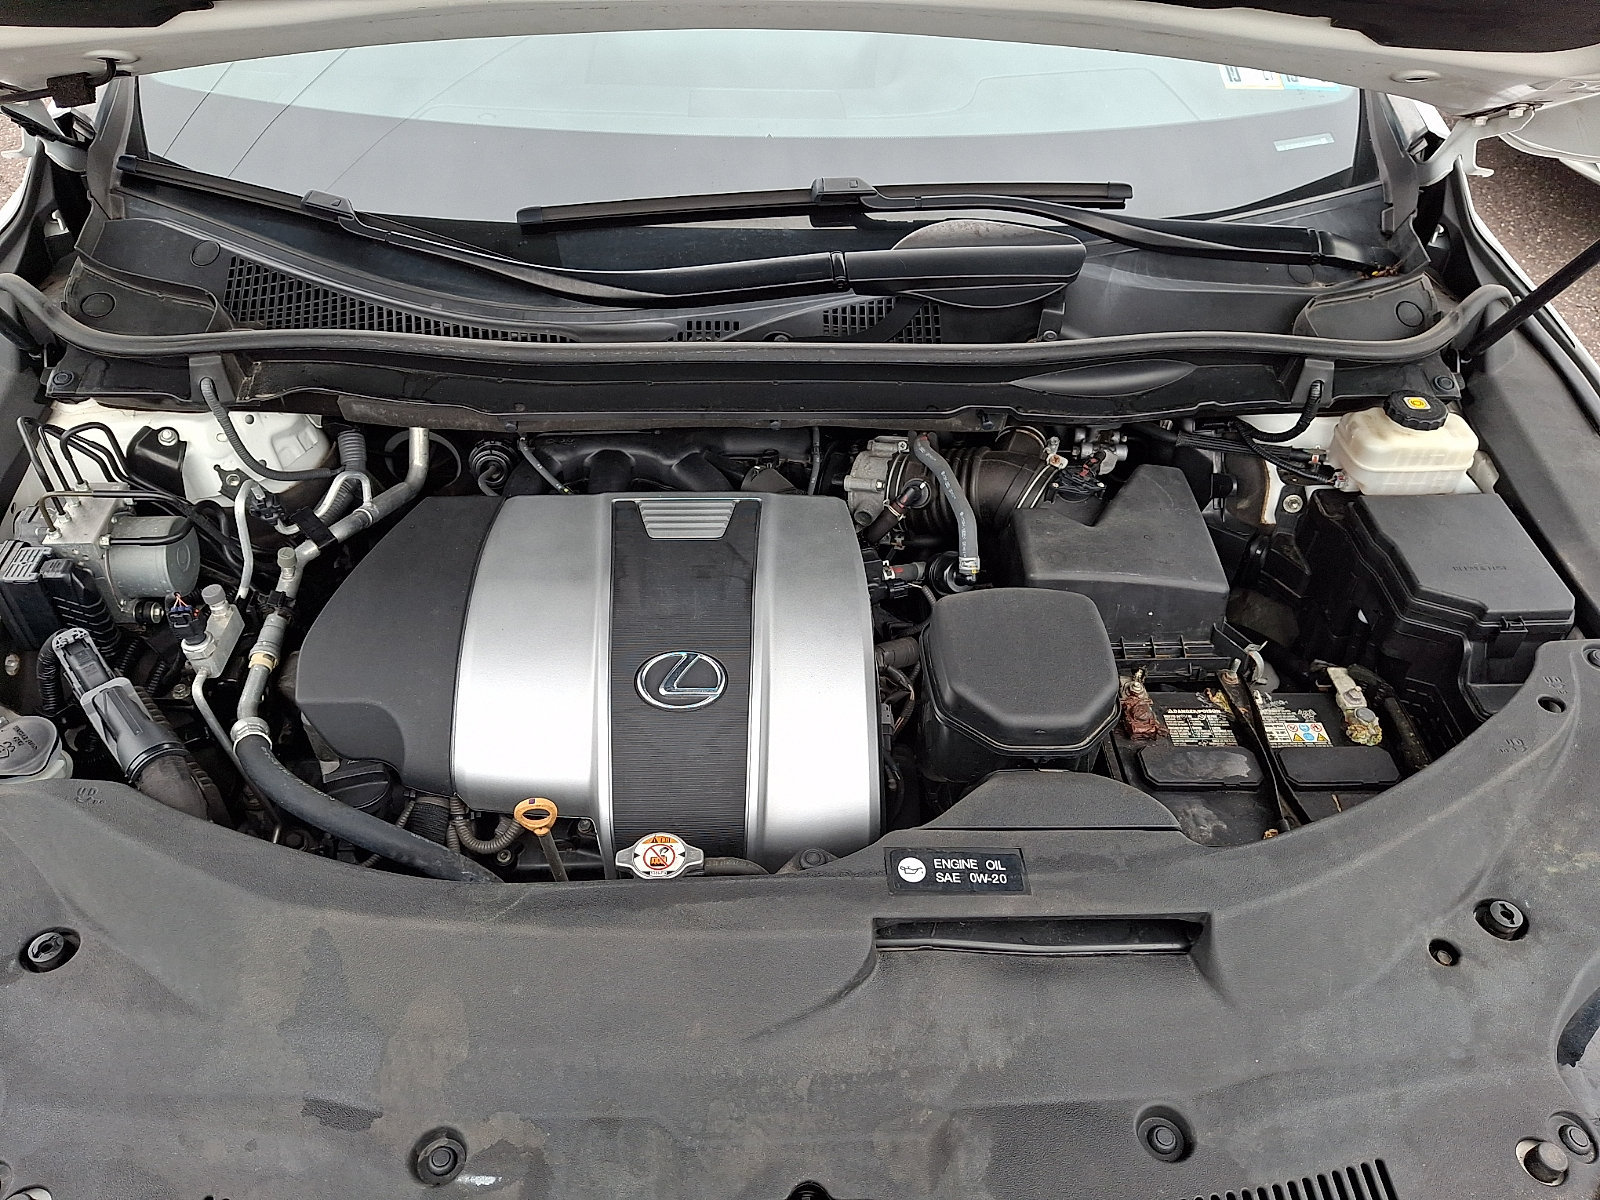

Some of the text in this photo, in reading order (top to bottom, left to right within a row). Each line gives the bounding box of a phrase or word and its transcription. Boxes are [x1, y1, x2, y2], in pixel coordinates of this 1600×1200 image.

[933, 858, 1007, 871] ENGINE OIL
[935, 872, 1008, 884] SAE 0W-20
